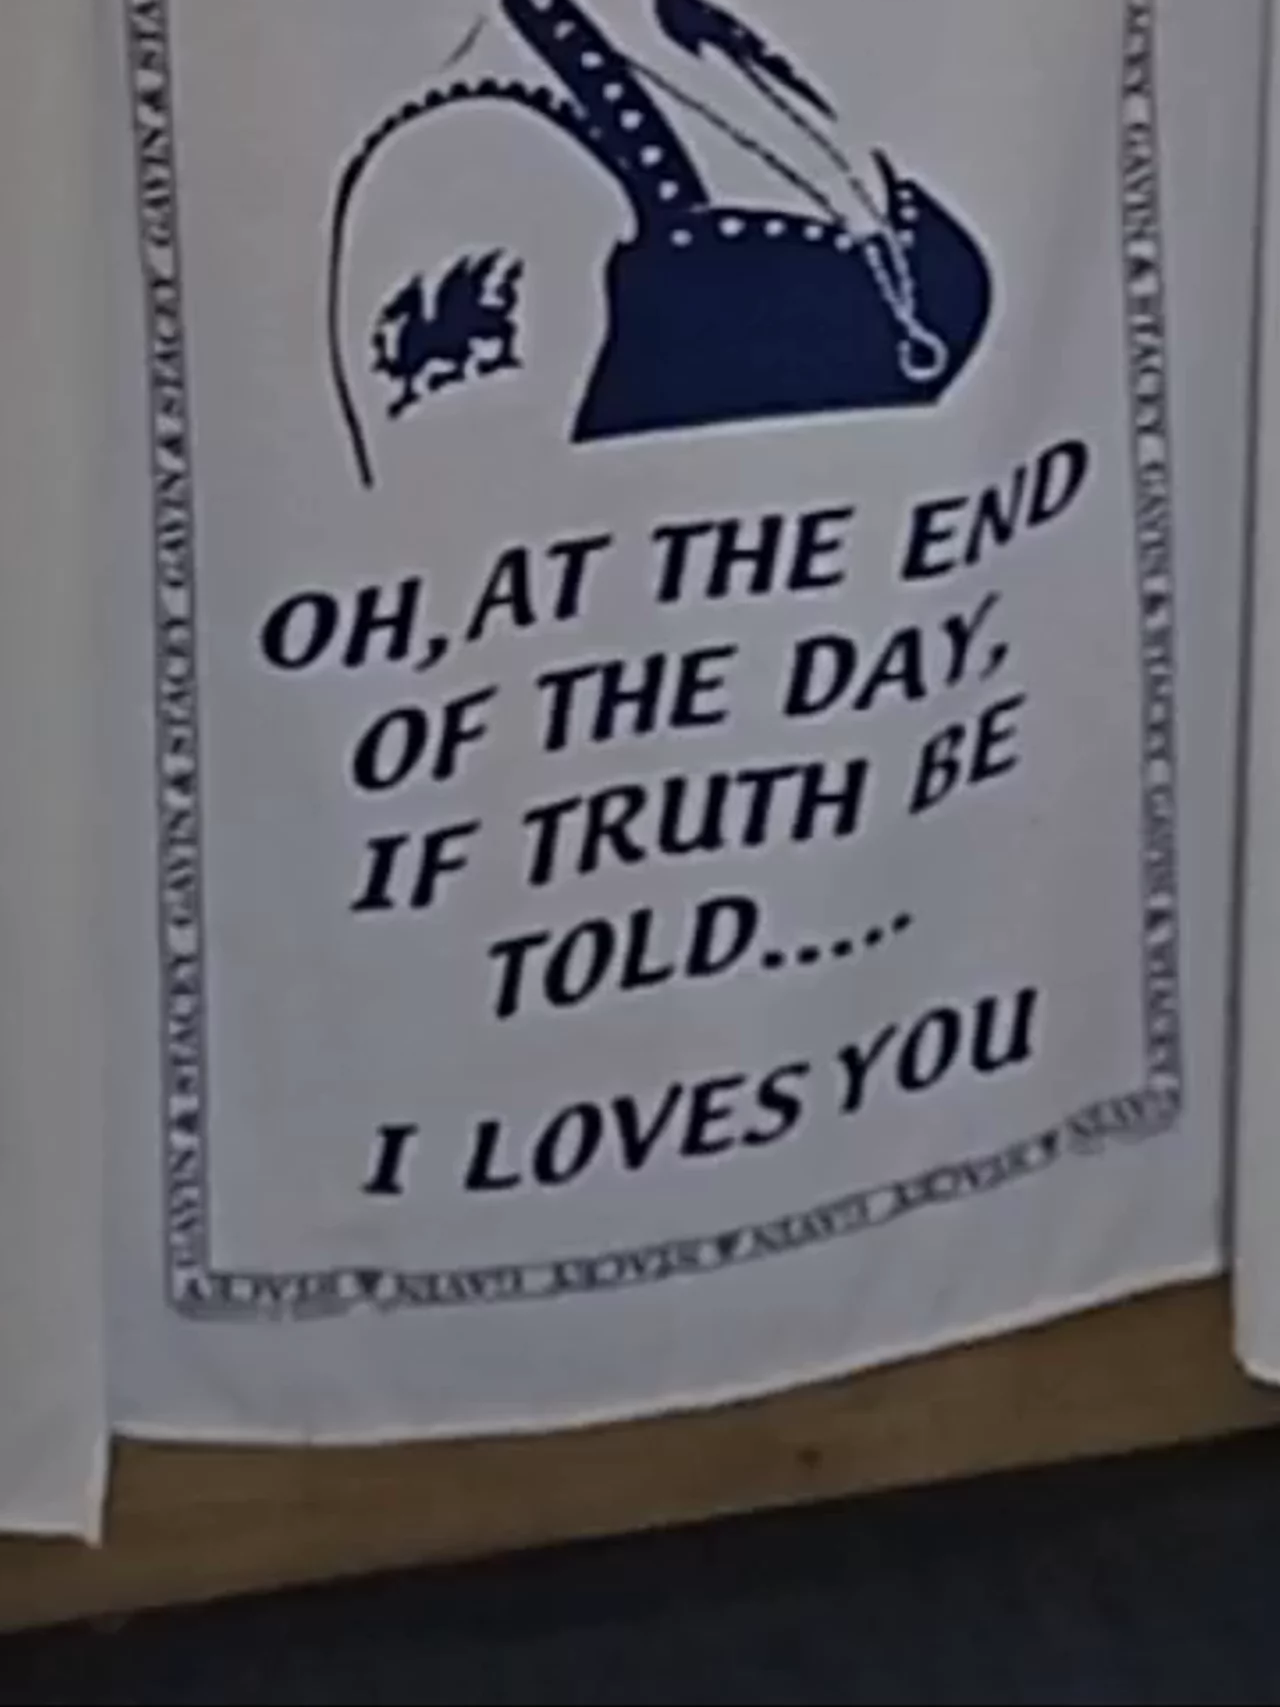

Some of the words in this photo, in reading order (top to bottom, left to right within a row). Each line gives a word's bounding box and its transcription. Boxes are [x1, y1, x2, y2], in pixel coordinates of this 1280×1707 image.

[649, 506, 856, 603] THE
[899, 438, 1093, 583] END
[350, 685, 499, 792] OF
[536, 646, 739, 754] THE
[783, 592, 1012, 718] DAY,
[350, 820, 481, 913] IF
[524, 758, 871, 889] TRUTH
[908, 694, 1028, 816] BE
[361, 1124, 421, 1196] I
[464, 1063, 812, 1194] LOVES
[831, 986, 1041, 1114] YOU
